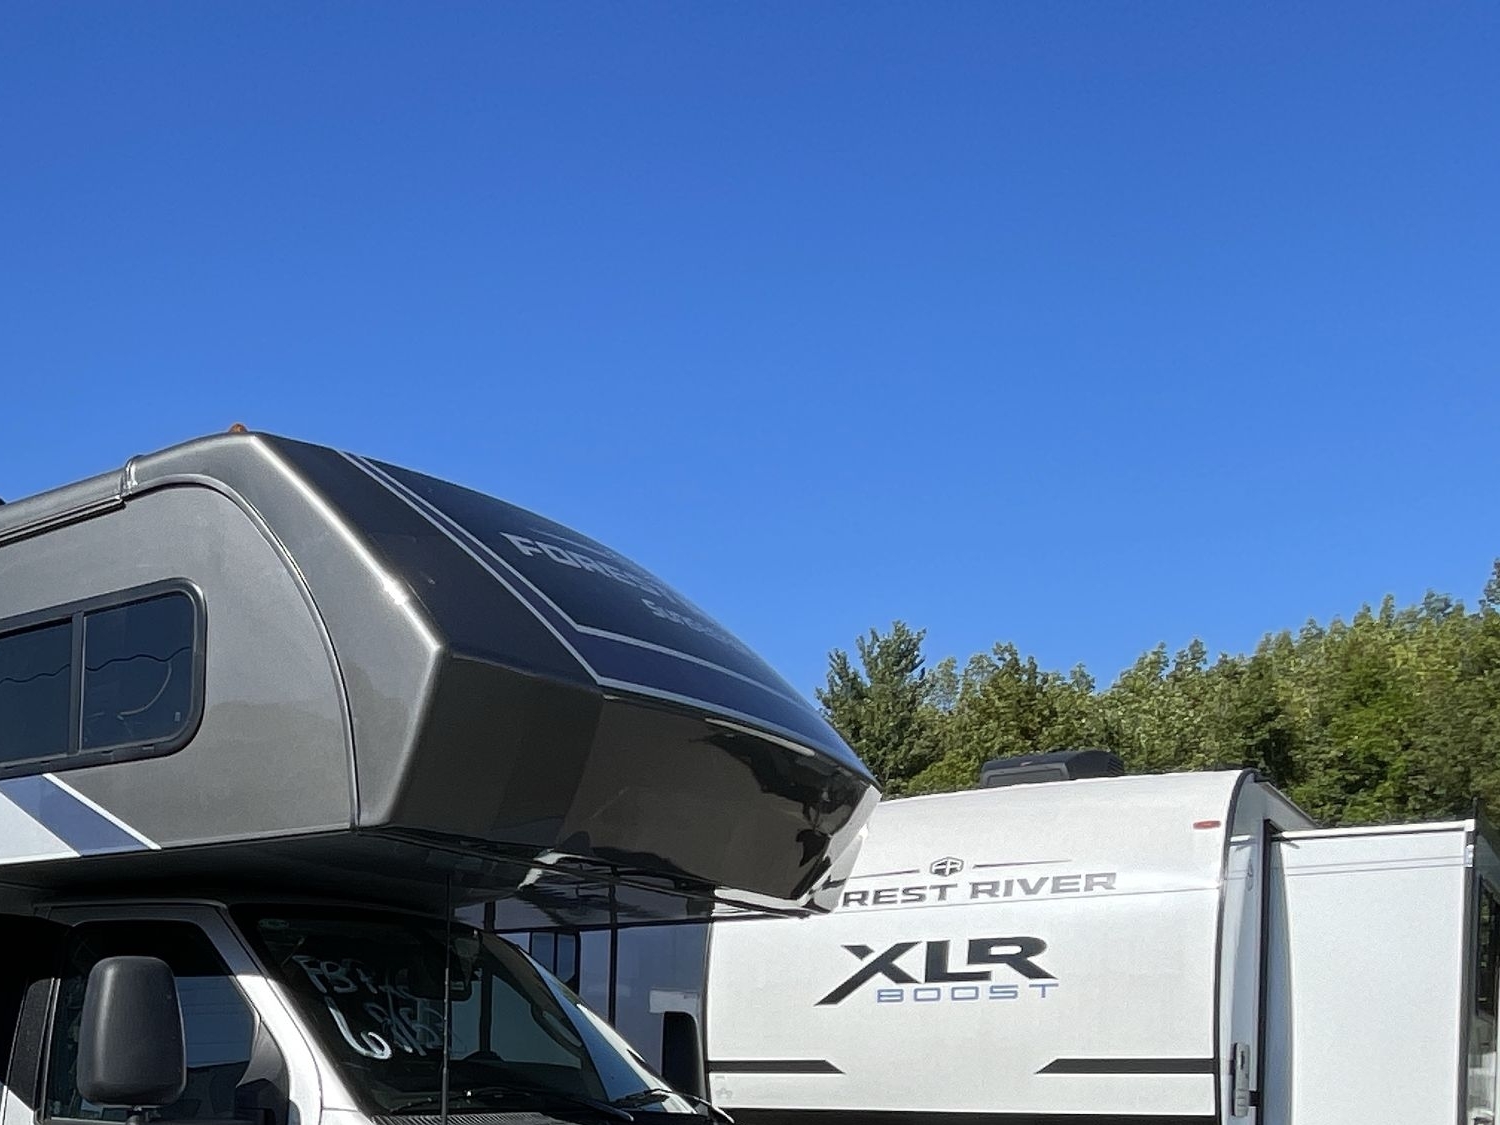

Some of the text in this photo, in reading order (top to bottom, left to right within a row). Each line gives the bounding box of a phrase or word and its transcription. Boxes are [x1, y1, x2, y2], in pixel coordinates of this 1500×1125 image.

[842, 873, 1116, 906] REST RIVER
[813, 936, 1058, 1006] XLR
[877, 984, 1058, 1003] BOOST
